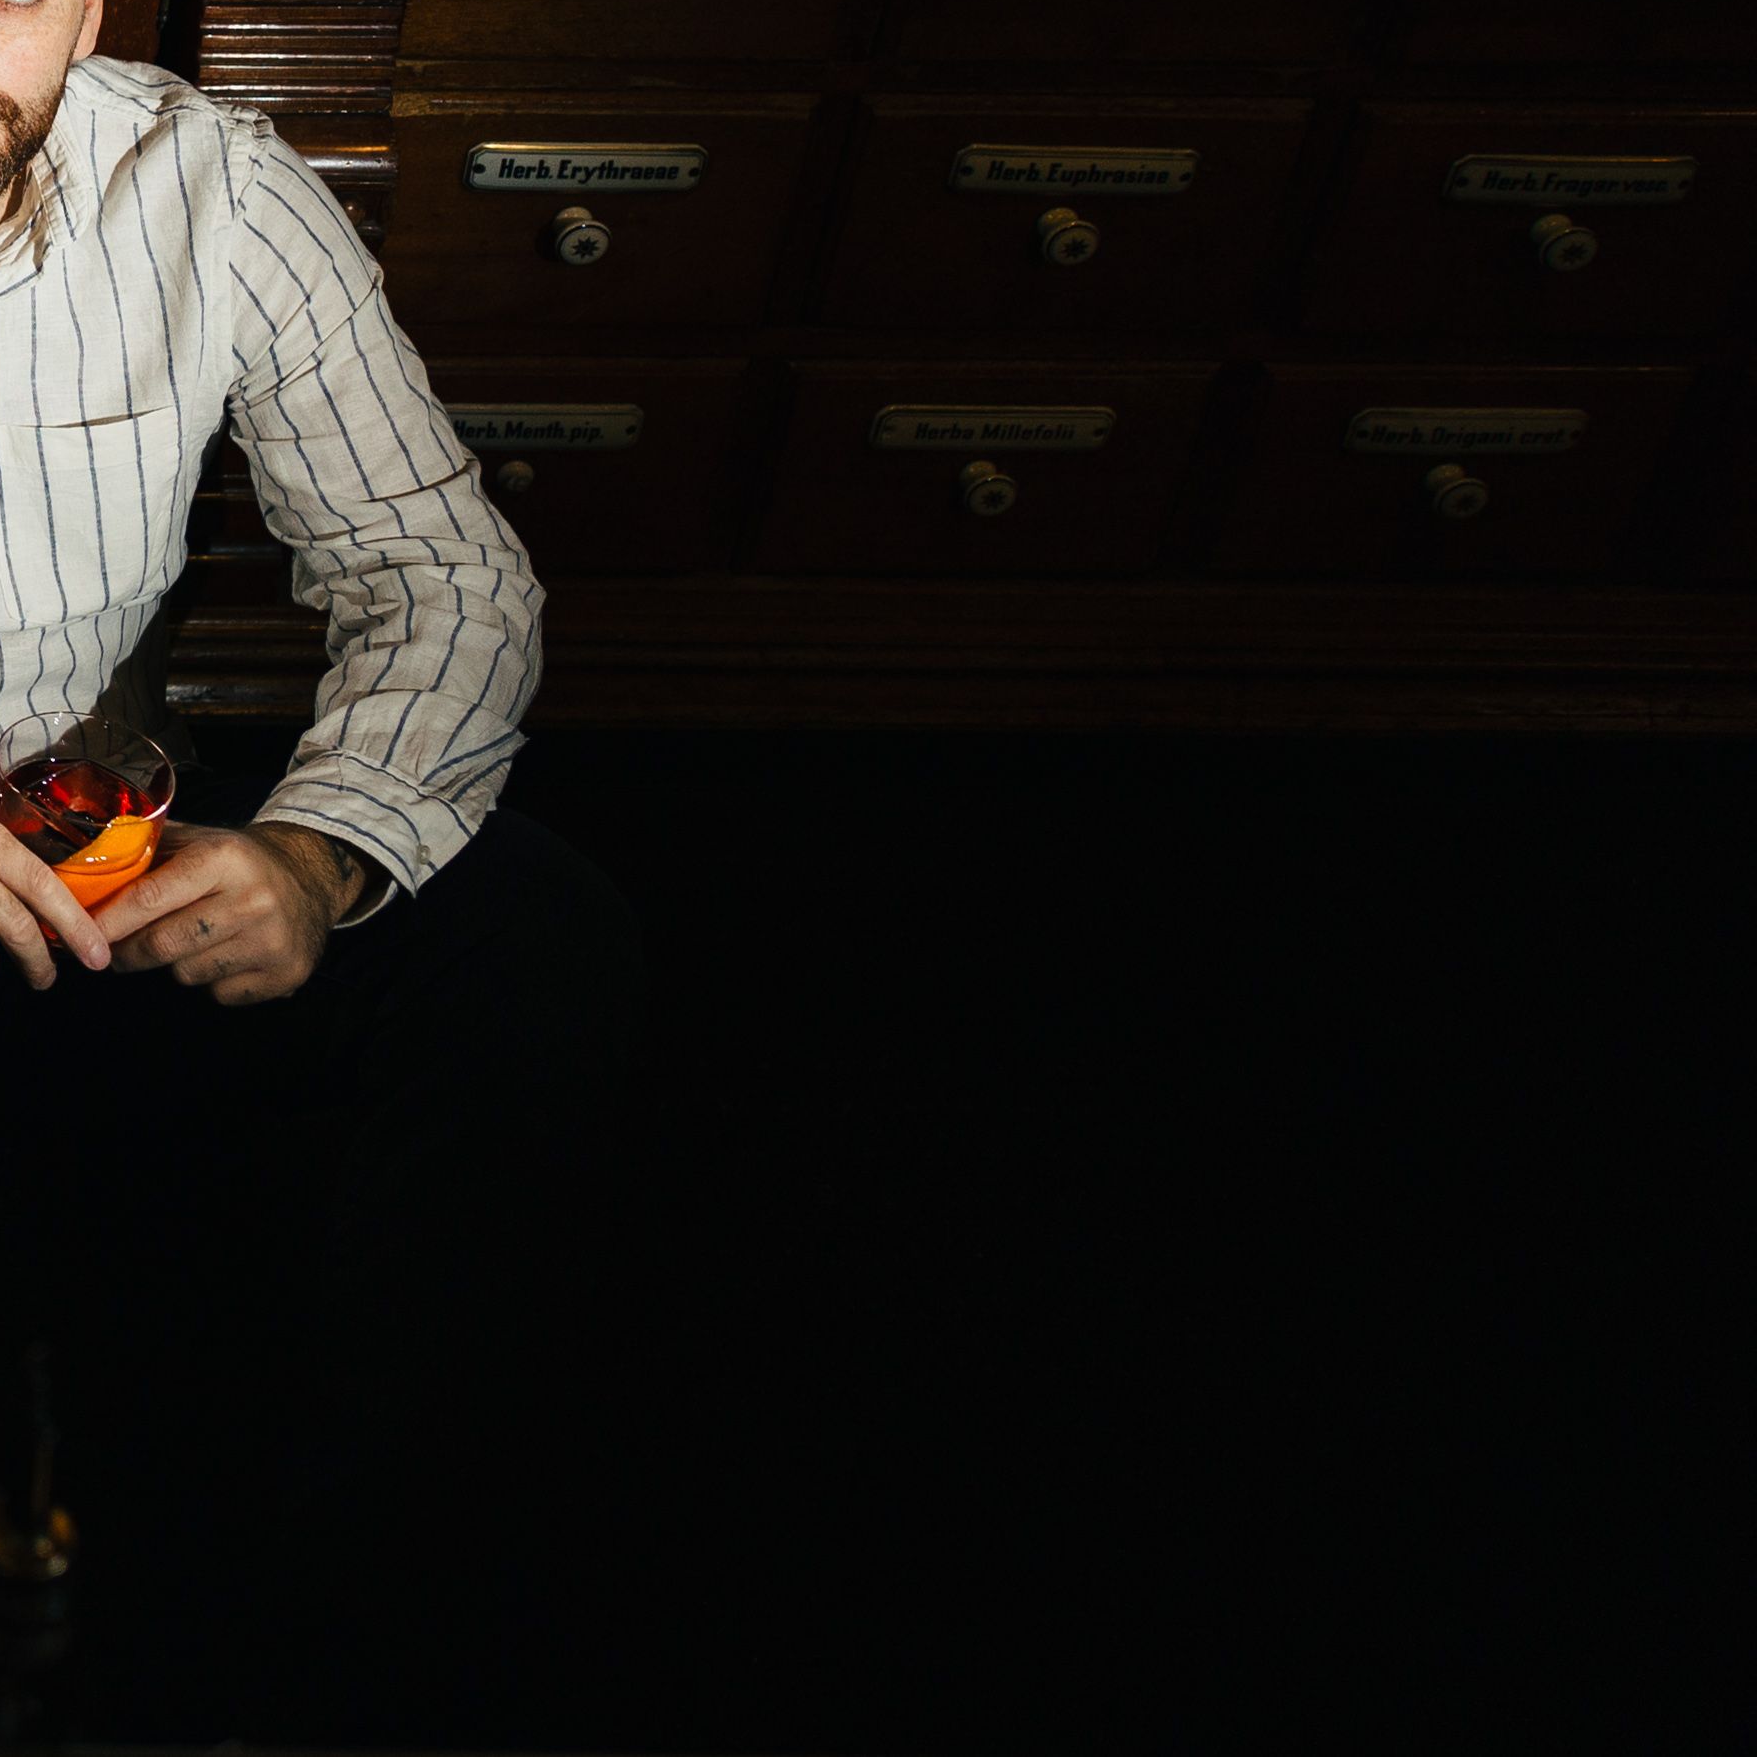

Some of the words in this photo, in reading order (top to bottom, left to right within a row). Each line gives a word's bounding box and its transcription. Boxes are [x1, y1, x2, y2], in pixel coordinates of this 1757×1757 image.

[498, 158, 553, 180] Herb.
[558, 158, 680, 185] Erythraeae
[1048, 161, 1169, 188] Euphrasiae
[571, 420, 604, 445] pip.
[913, 421, 975, 442] Herba
[981, 421, 1075, 442] Millefolii
